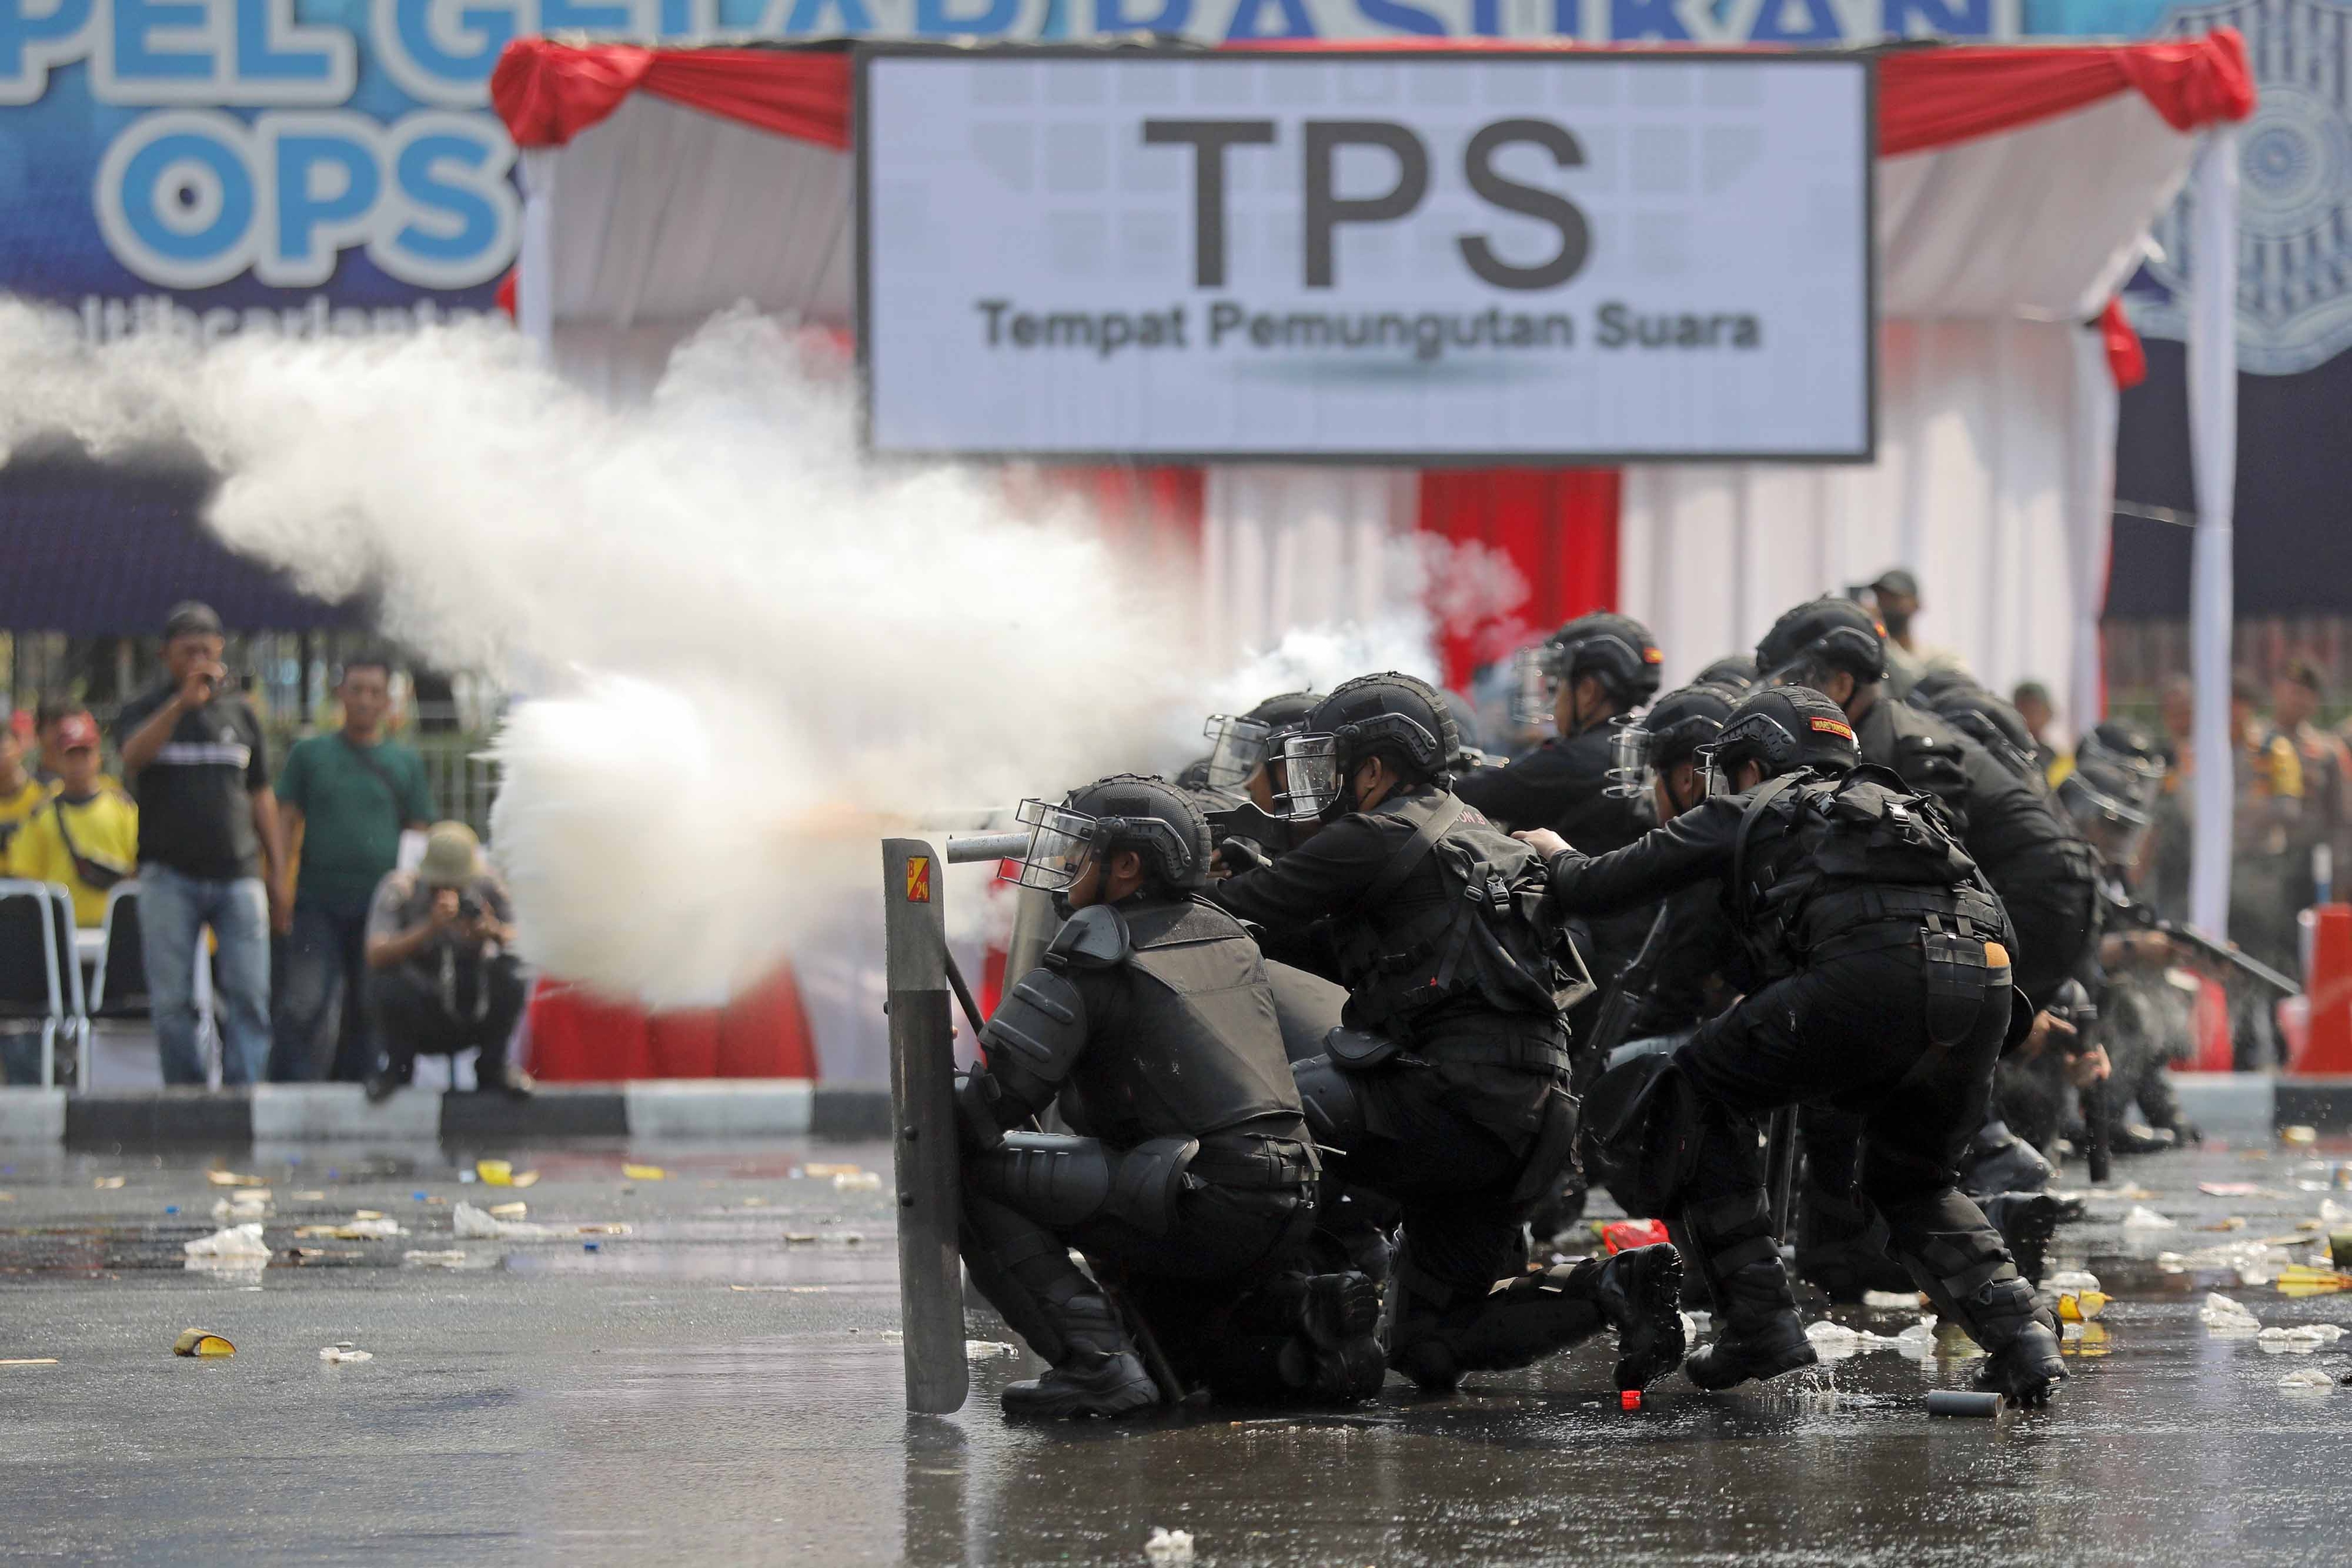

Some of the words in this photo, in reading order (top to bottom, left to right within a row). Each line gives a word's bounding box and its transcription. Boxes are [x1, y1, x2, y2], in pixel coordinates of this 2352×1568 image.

[109, 123, 512, 276] OPS
[1143, 118, 1590, 290] TPS
[979, 300, 1185, 355] Tempat
[1210, 301, 1572, 359] Pemungutan
[1597, 303, 1758, 348] Suara
[908, 859, 914, 878] B
[916, 881, 928, 899] 29
